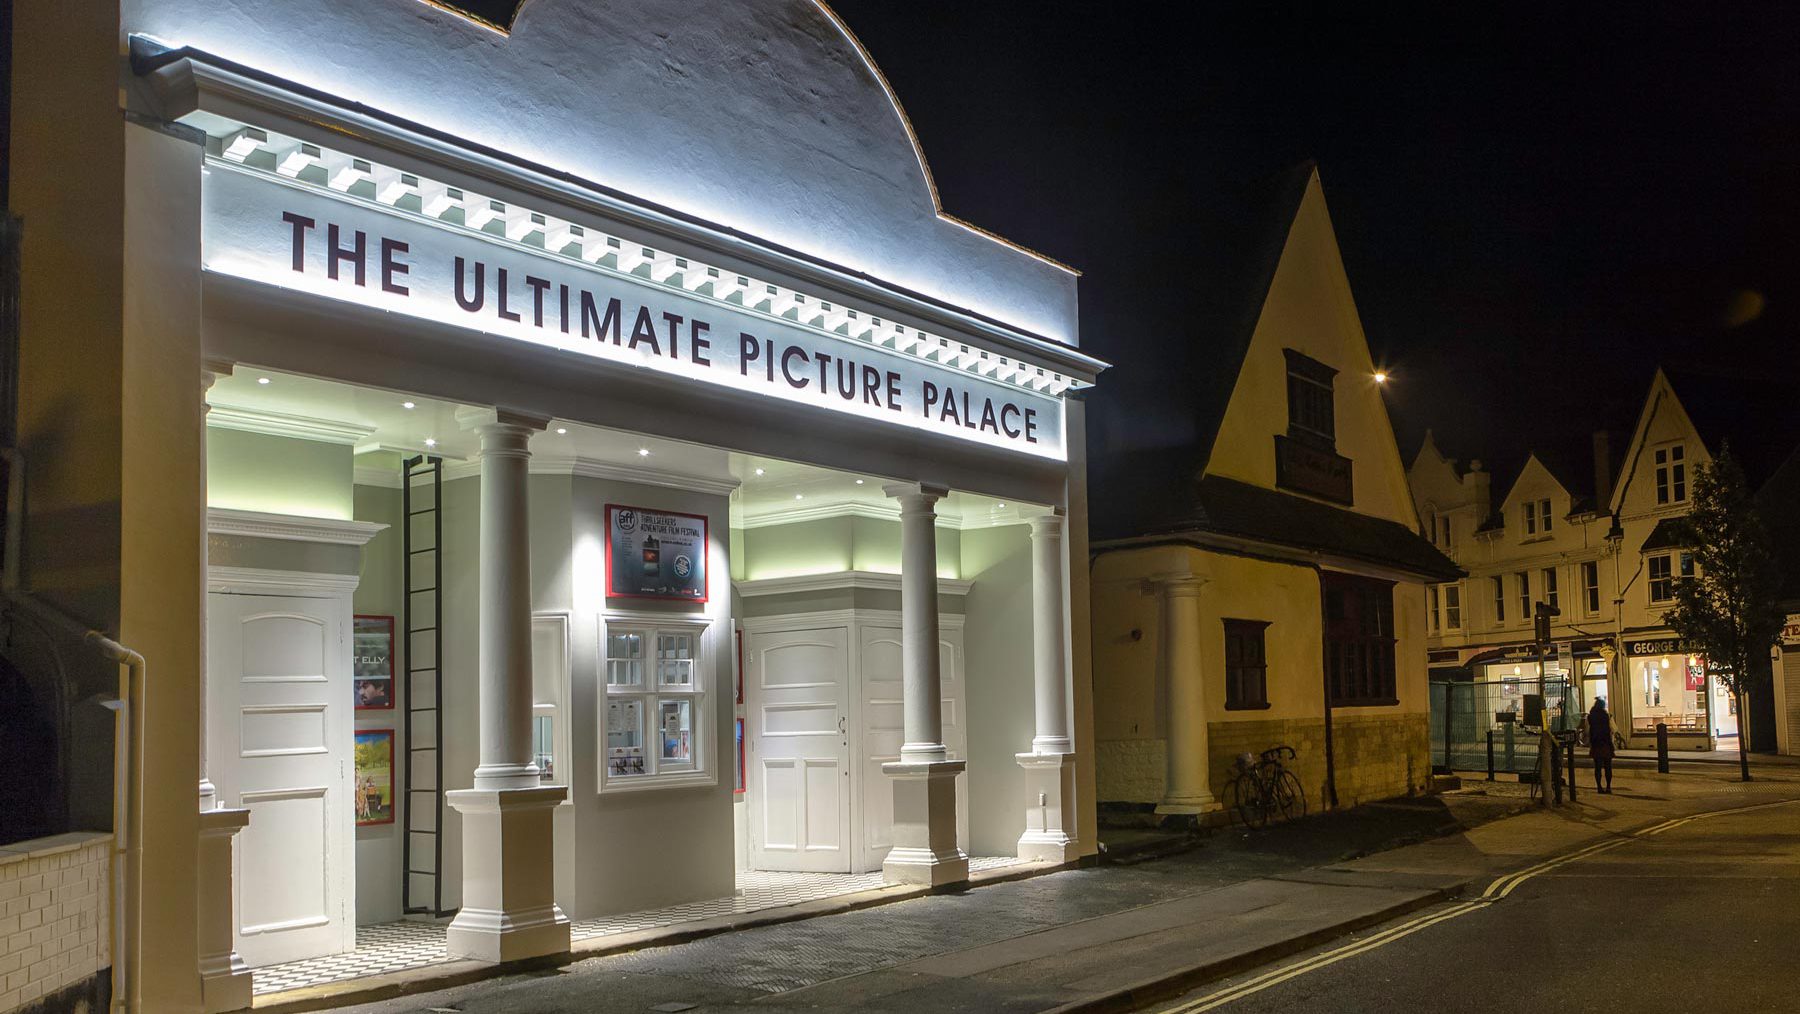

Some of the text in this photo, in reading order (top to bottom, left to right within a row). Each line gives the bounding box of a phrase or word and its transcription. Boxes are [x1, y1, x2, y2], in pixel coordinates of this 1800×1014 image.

[282, 210, 1037, 444] THE ULTIMATE PICTURE PALACE
[620, 512, 634, 524] aff
[640, 524, 700, 538] ADVENTURE FILM FESTIVAL
[1633, 640, 1674, 655] GEORGE
[1678, 640, 1686, 652] &
[362, 656, 385, 664] ELLY
